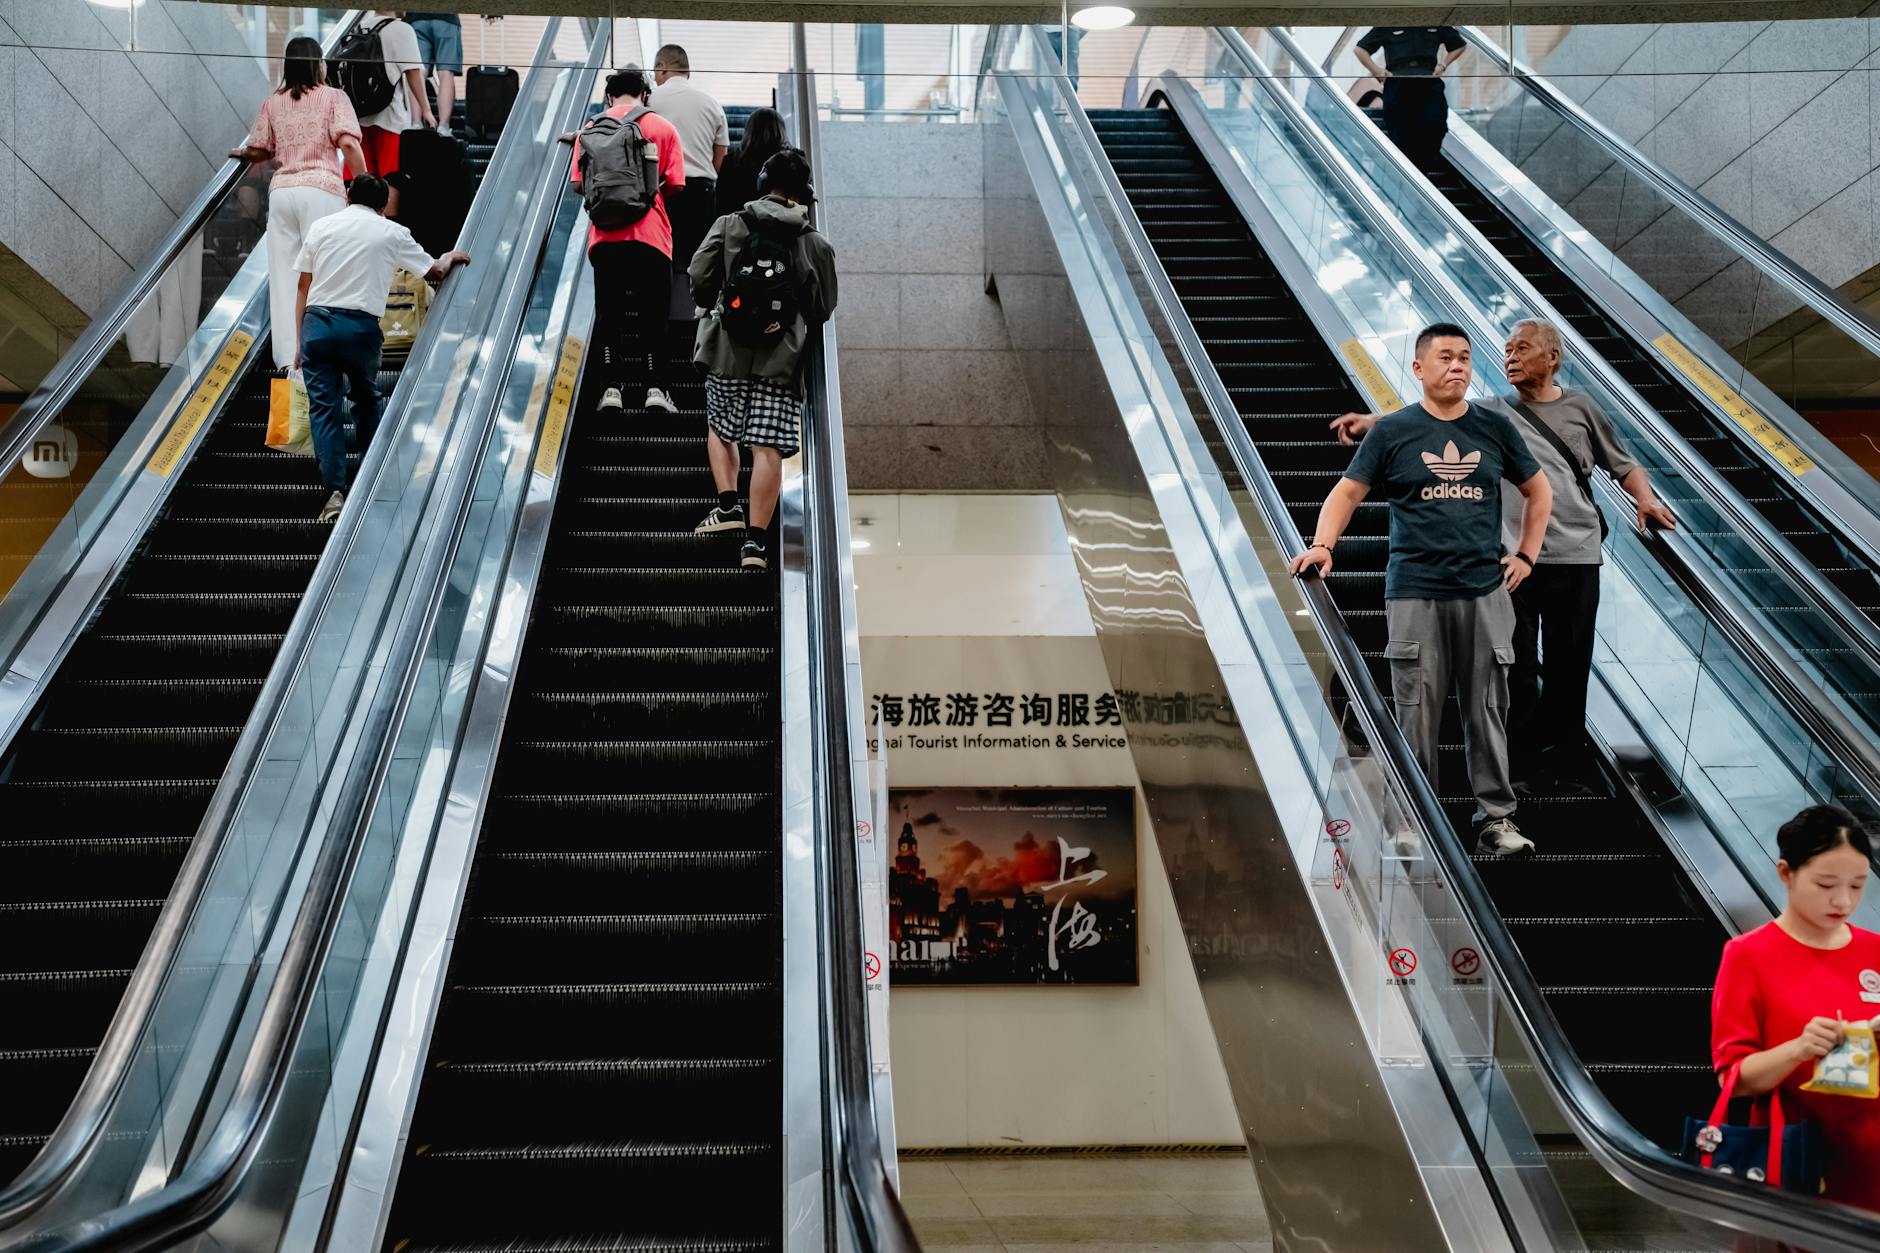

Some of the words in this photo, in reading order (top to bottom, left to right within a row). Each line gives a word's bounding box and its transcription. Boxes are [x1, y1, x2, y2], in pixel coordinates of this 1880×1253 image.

[1421, 483, 1483, 500] adidas
[908, 735, 958, 749] Tourist
[964, 734, 1050, 748] Information
[1056, 734, 1066, 748] &
[1072, 734, 1126, 748] Service
